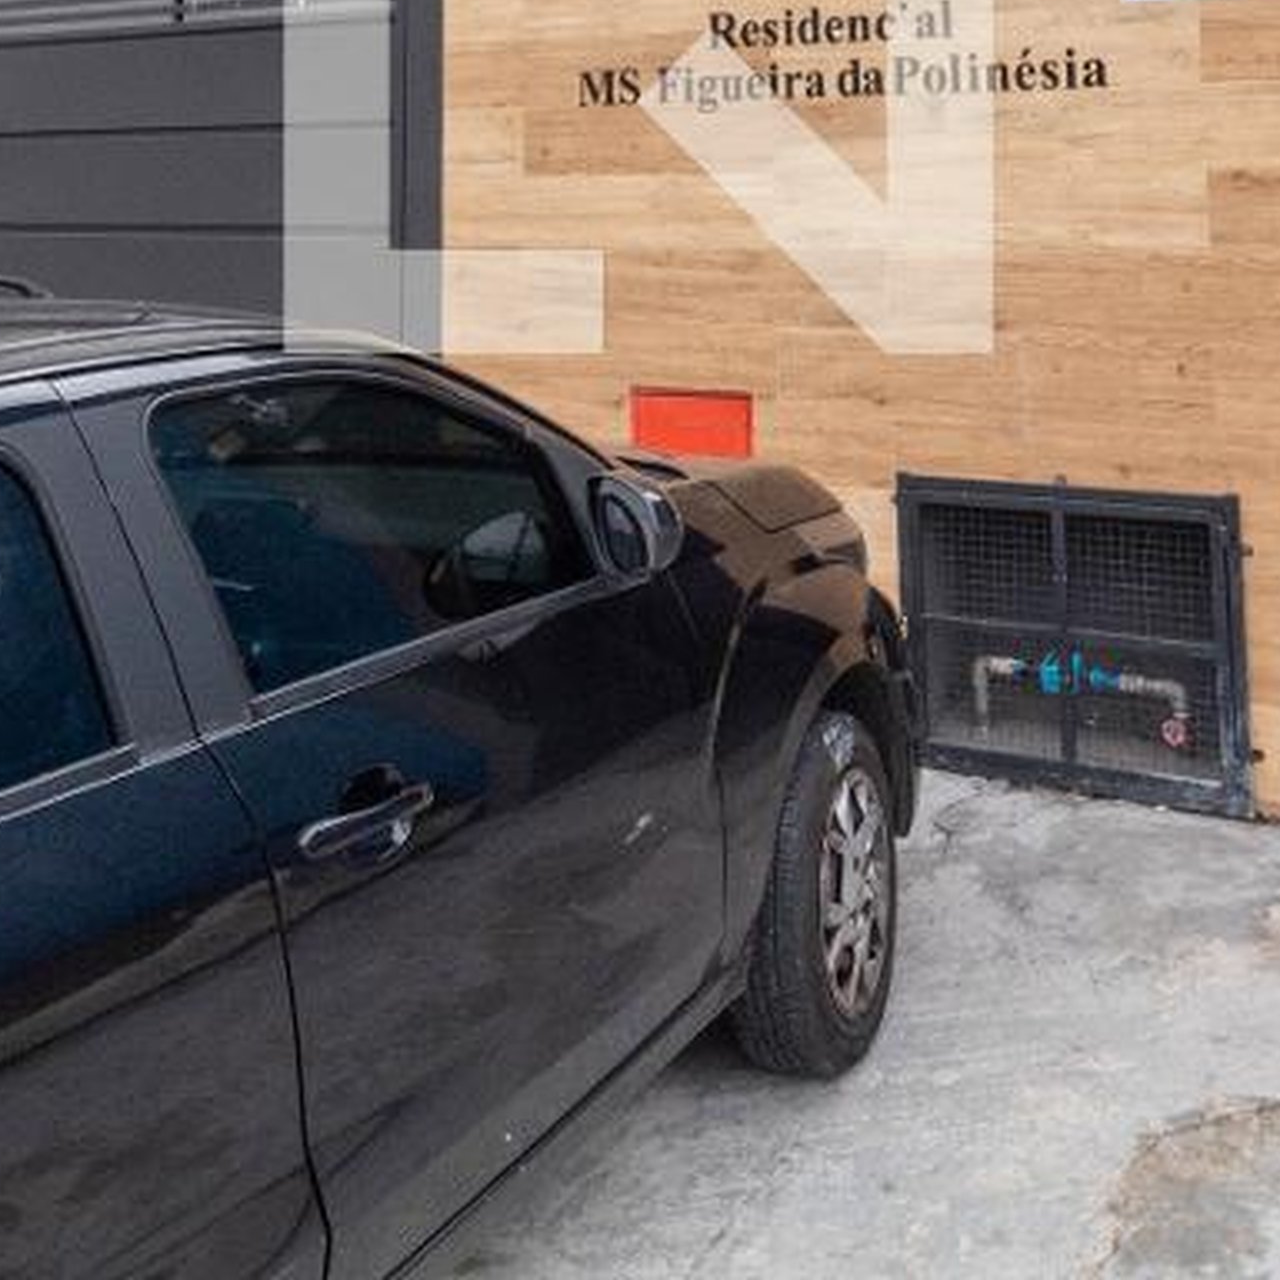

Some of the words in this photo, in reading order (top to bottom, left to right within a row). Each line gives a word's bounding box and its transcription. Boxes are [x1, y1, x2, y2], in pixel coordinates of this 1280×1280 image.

[709, 0, 953, 50] Residencal
[578, 65, 641, 108] MS
[658, 63, 827, 114] Figueira
[837, 59, 886, 98] da
[893, 47, 1108, 96] Polinésia
